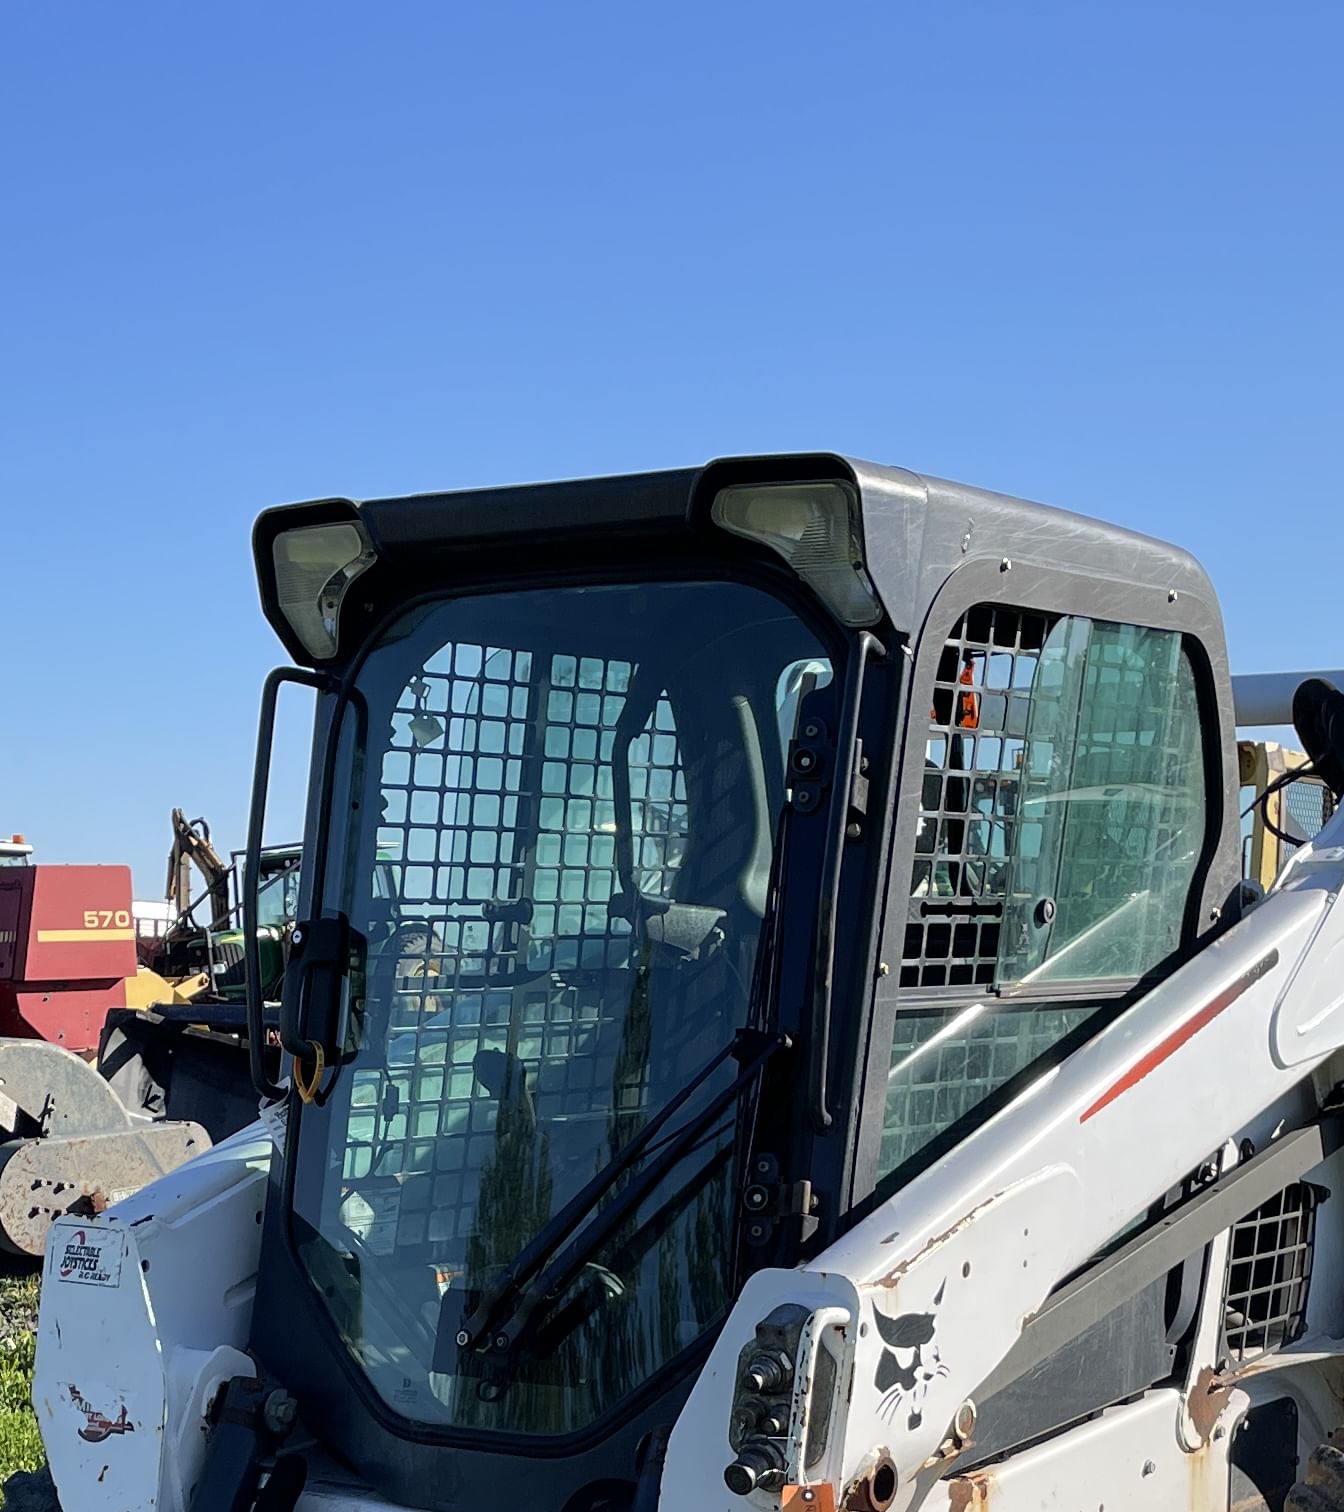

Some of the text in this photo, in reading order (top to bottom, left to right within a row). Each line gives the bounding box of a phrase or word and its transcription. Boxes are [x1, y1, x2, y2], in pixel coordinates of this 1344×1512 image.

[83, 910, 130, 928] 570
[65, 1245, 102, 1258] SELECTABLE
[60, 1256, 98, 1271] JOYSTICKS
